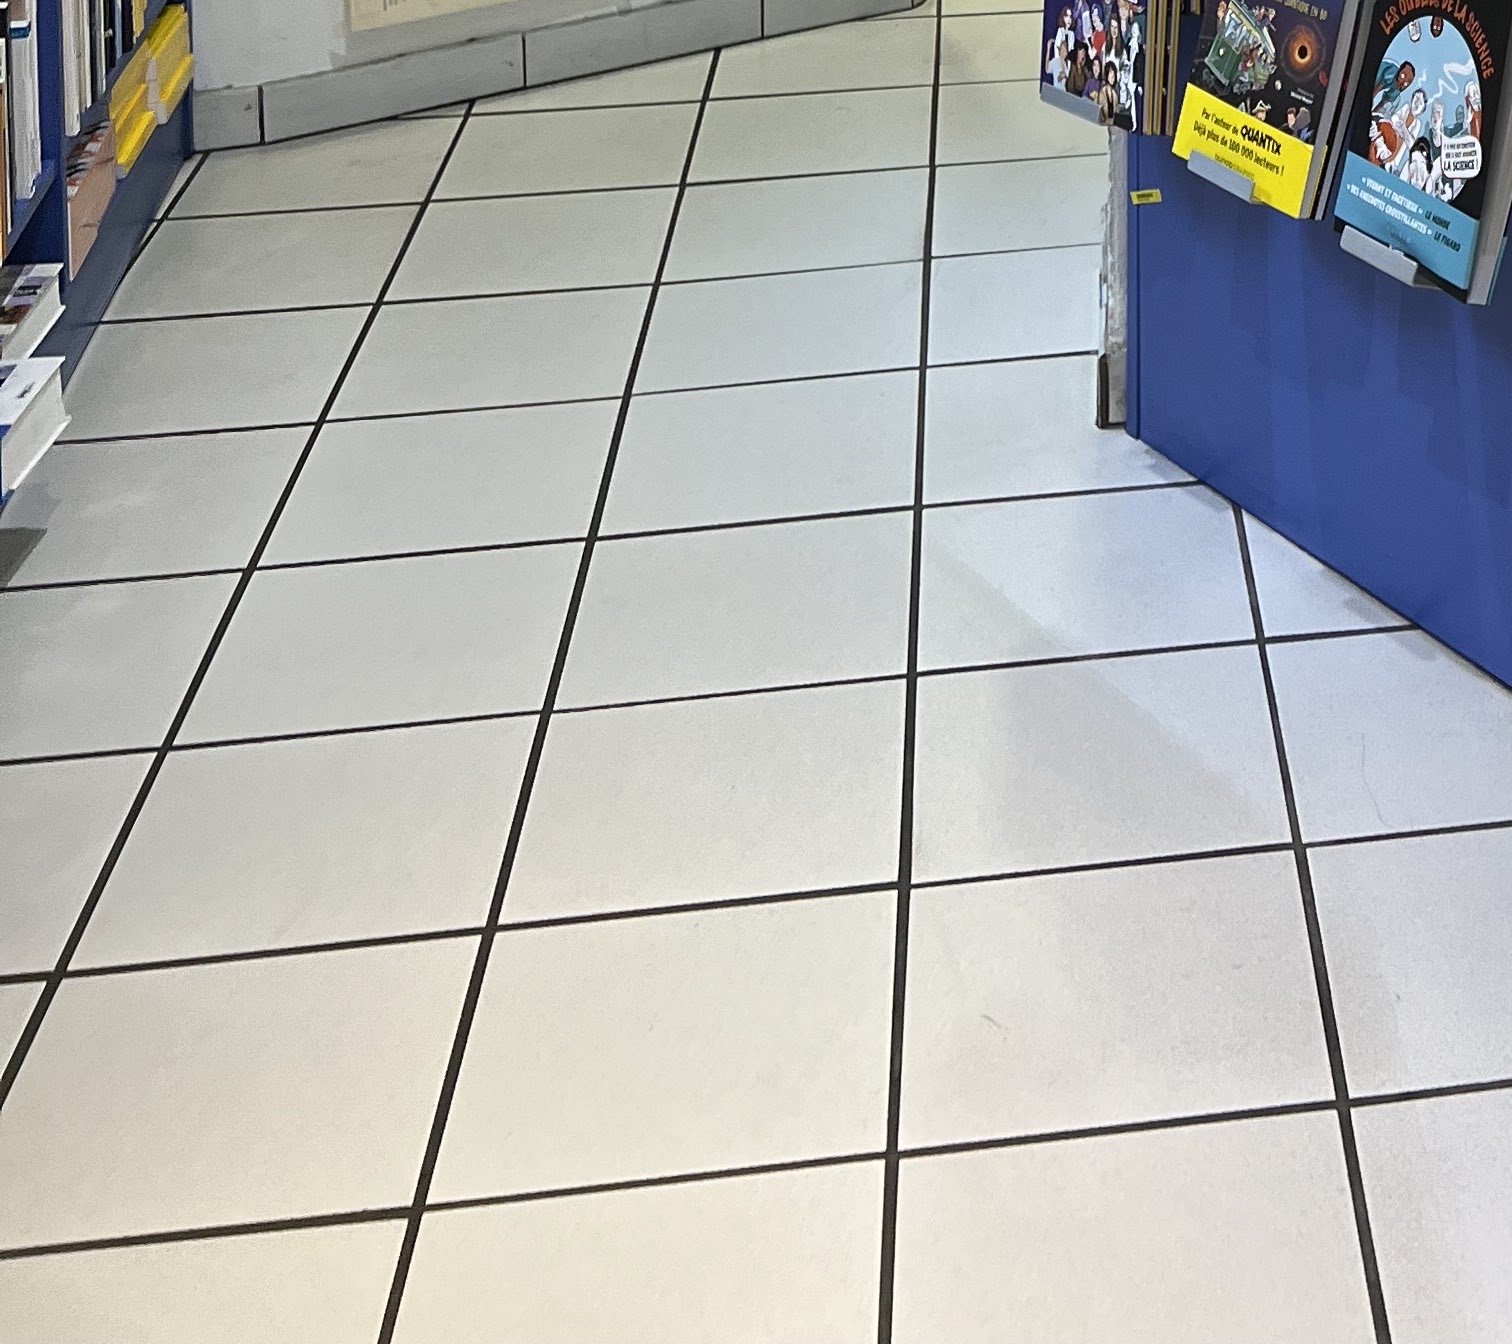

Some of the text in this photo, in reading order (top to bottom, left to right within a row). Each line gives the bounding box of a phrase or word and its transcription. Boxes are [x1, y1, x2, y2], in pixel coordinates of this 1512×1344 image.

[1379, 4, 1399, 36] LES
[1465, 11, 1495, 80] SCIENCE
[1193, 119, 1280, 176] Déjà plus lecteurs
[1239, 124, 1282, 157] QUANTIX
[1441, 236, 1461, 255] FIGARO
